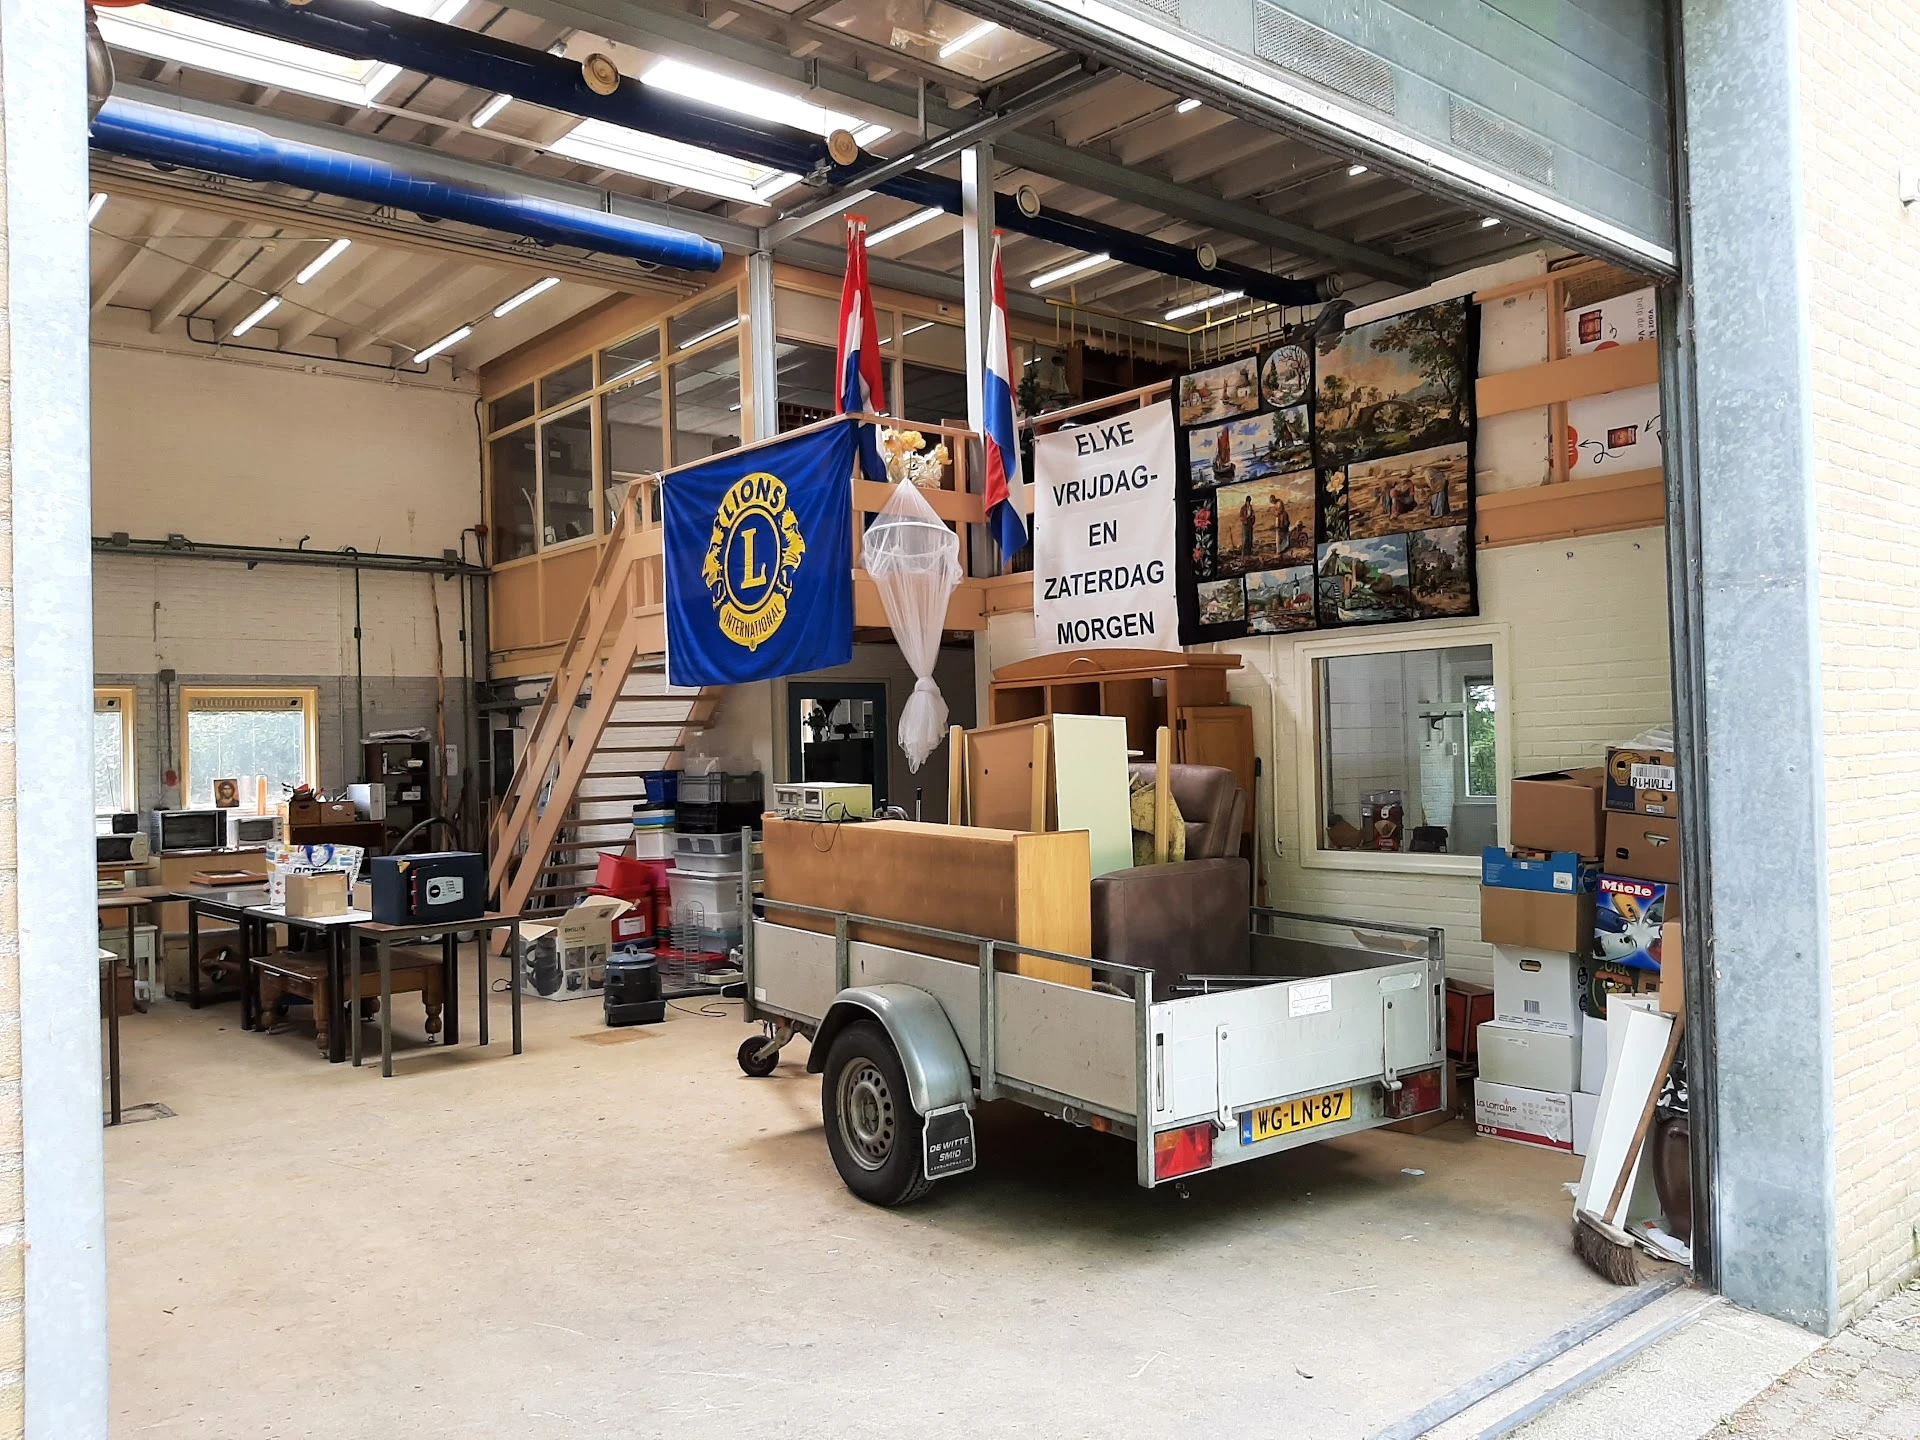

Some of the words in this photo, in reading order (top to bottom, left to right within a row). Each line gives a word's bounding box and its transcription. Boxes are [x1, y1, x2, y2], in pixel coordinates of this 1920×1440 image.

[1074, 421, 1135, 457] ELKE
[722, 477, 783, 522] LIONS
[1052, 464, 1159, 507] VRIJDAG-
[1089, 519, 1118, 548] EN
[741, 527, 767, 589] L
[1043, 560, 1165, 601] ZATERDAG
[723, 601, 782, 639] INTERNATIONAL
[1057, 610, 1155, 645] MORGEN
[1631, 776, 1674, 791] FTMH18
[1601, 879, 1652, 897] Miele
[1257, 1092, 1344, 1135] WG-LN-87
[942, 1135, 970, 1150] WITTE
[1243, 1130, 1252, 1138] NL
[939, 1149, 962, 1162] SMID
